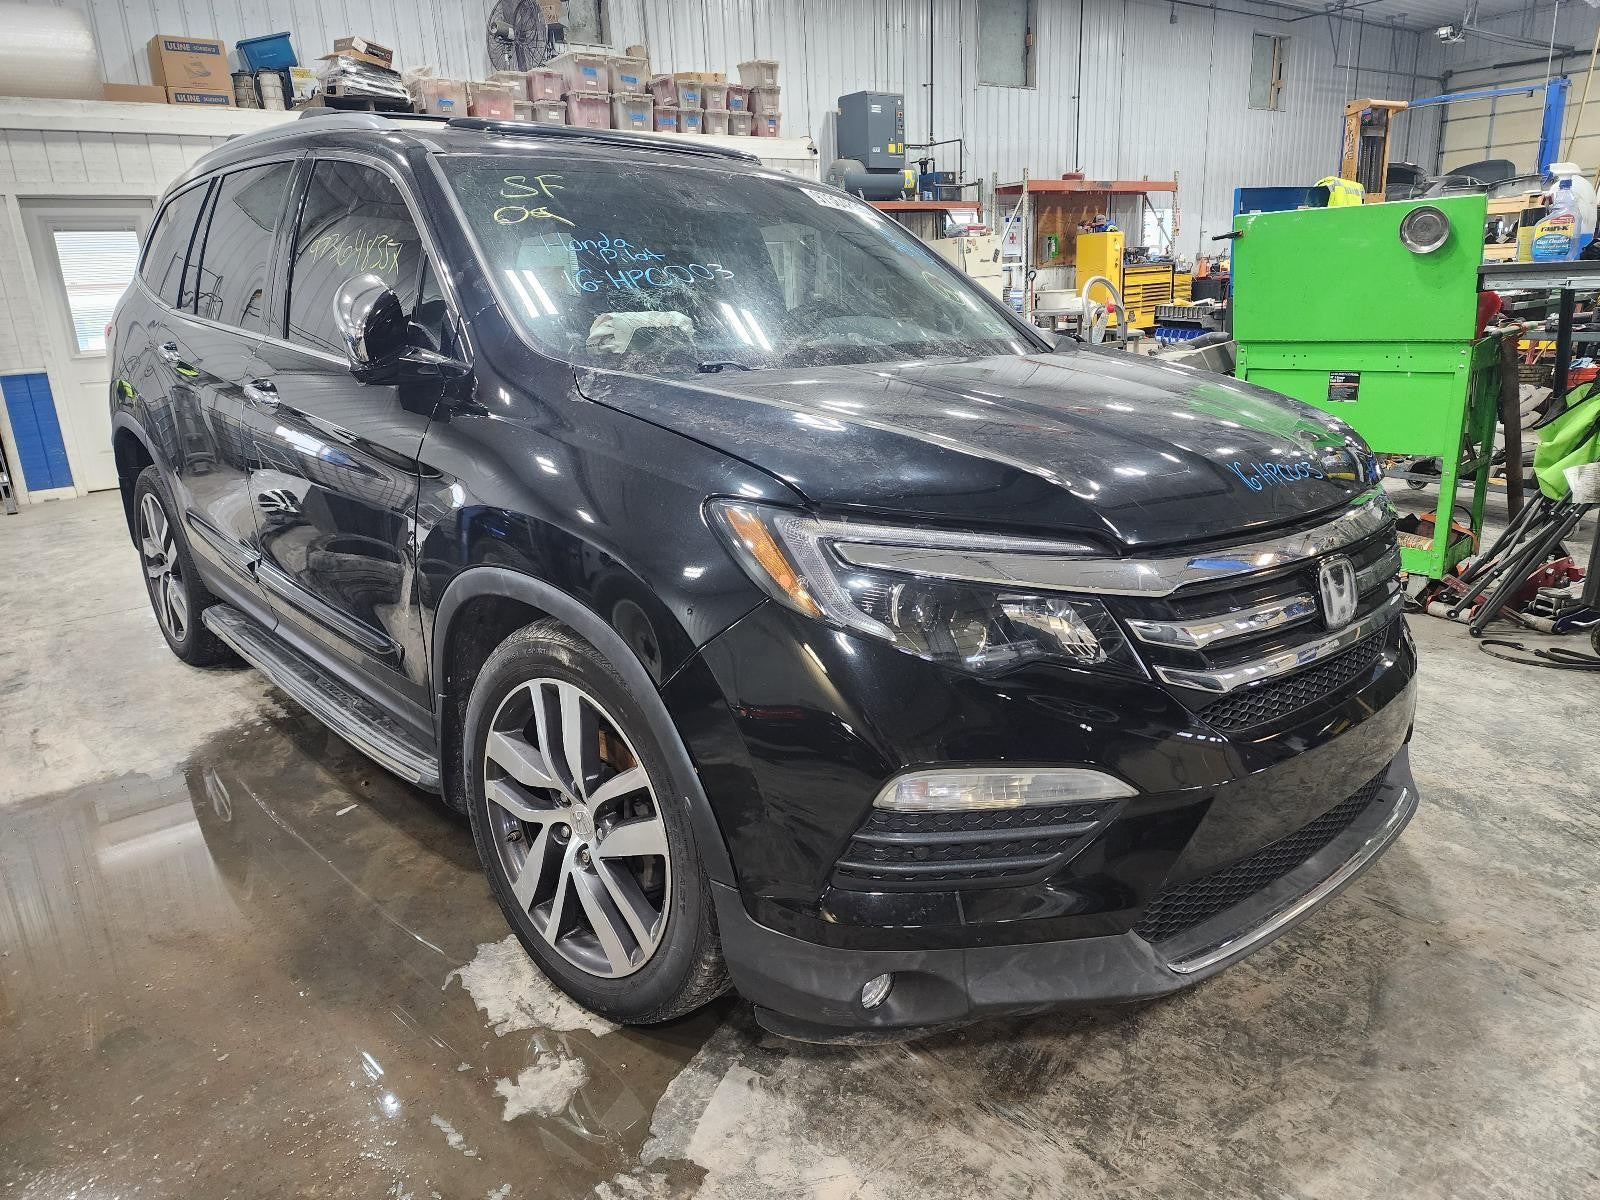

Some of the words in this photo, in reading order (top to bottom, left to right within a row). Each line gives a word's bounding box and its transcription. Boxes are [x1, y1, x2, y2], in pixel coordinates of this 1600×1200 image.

[167, 42, 191, 51] ULINE
[176, 94, 200, 102] ULINE
[501, 174, 565, 199] SF
[539, 231, 635, 254] Honda
[599, 247, 667, 265] Pilot
